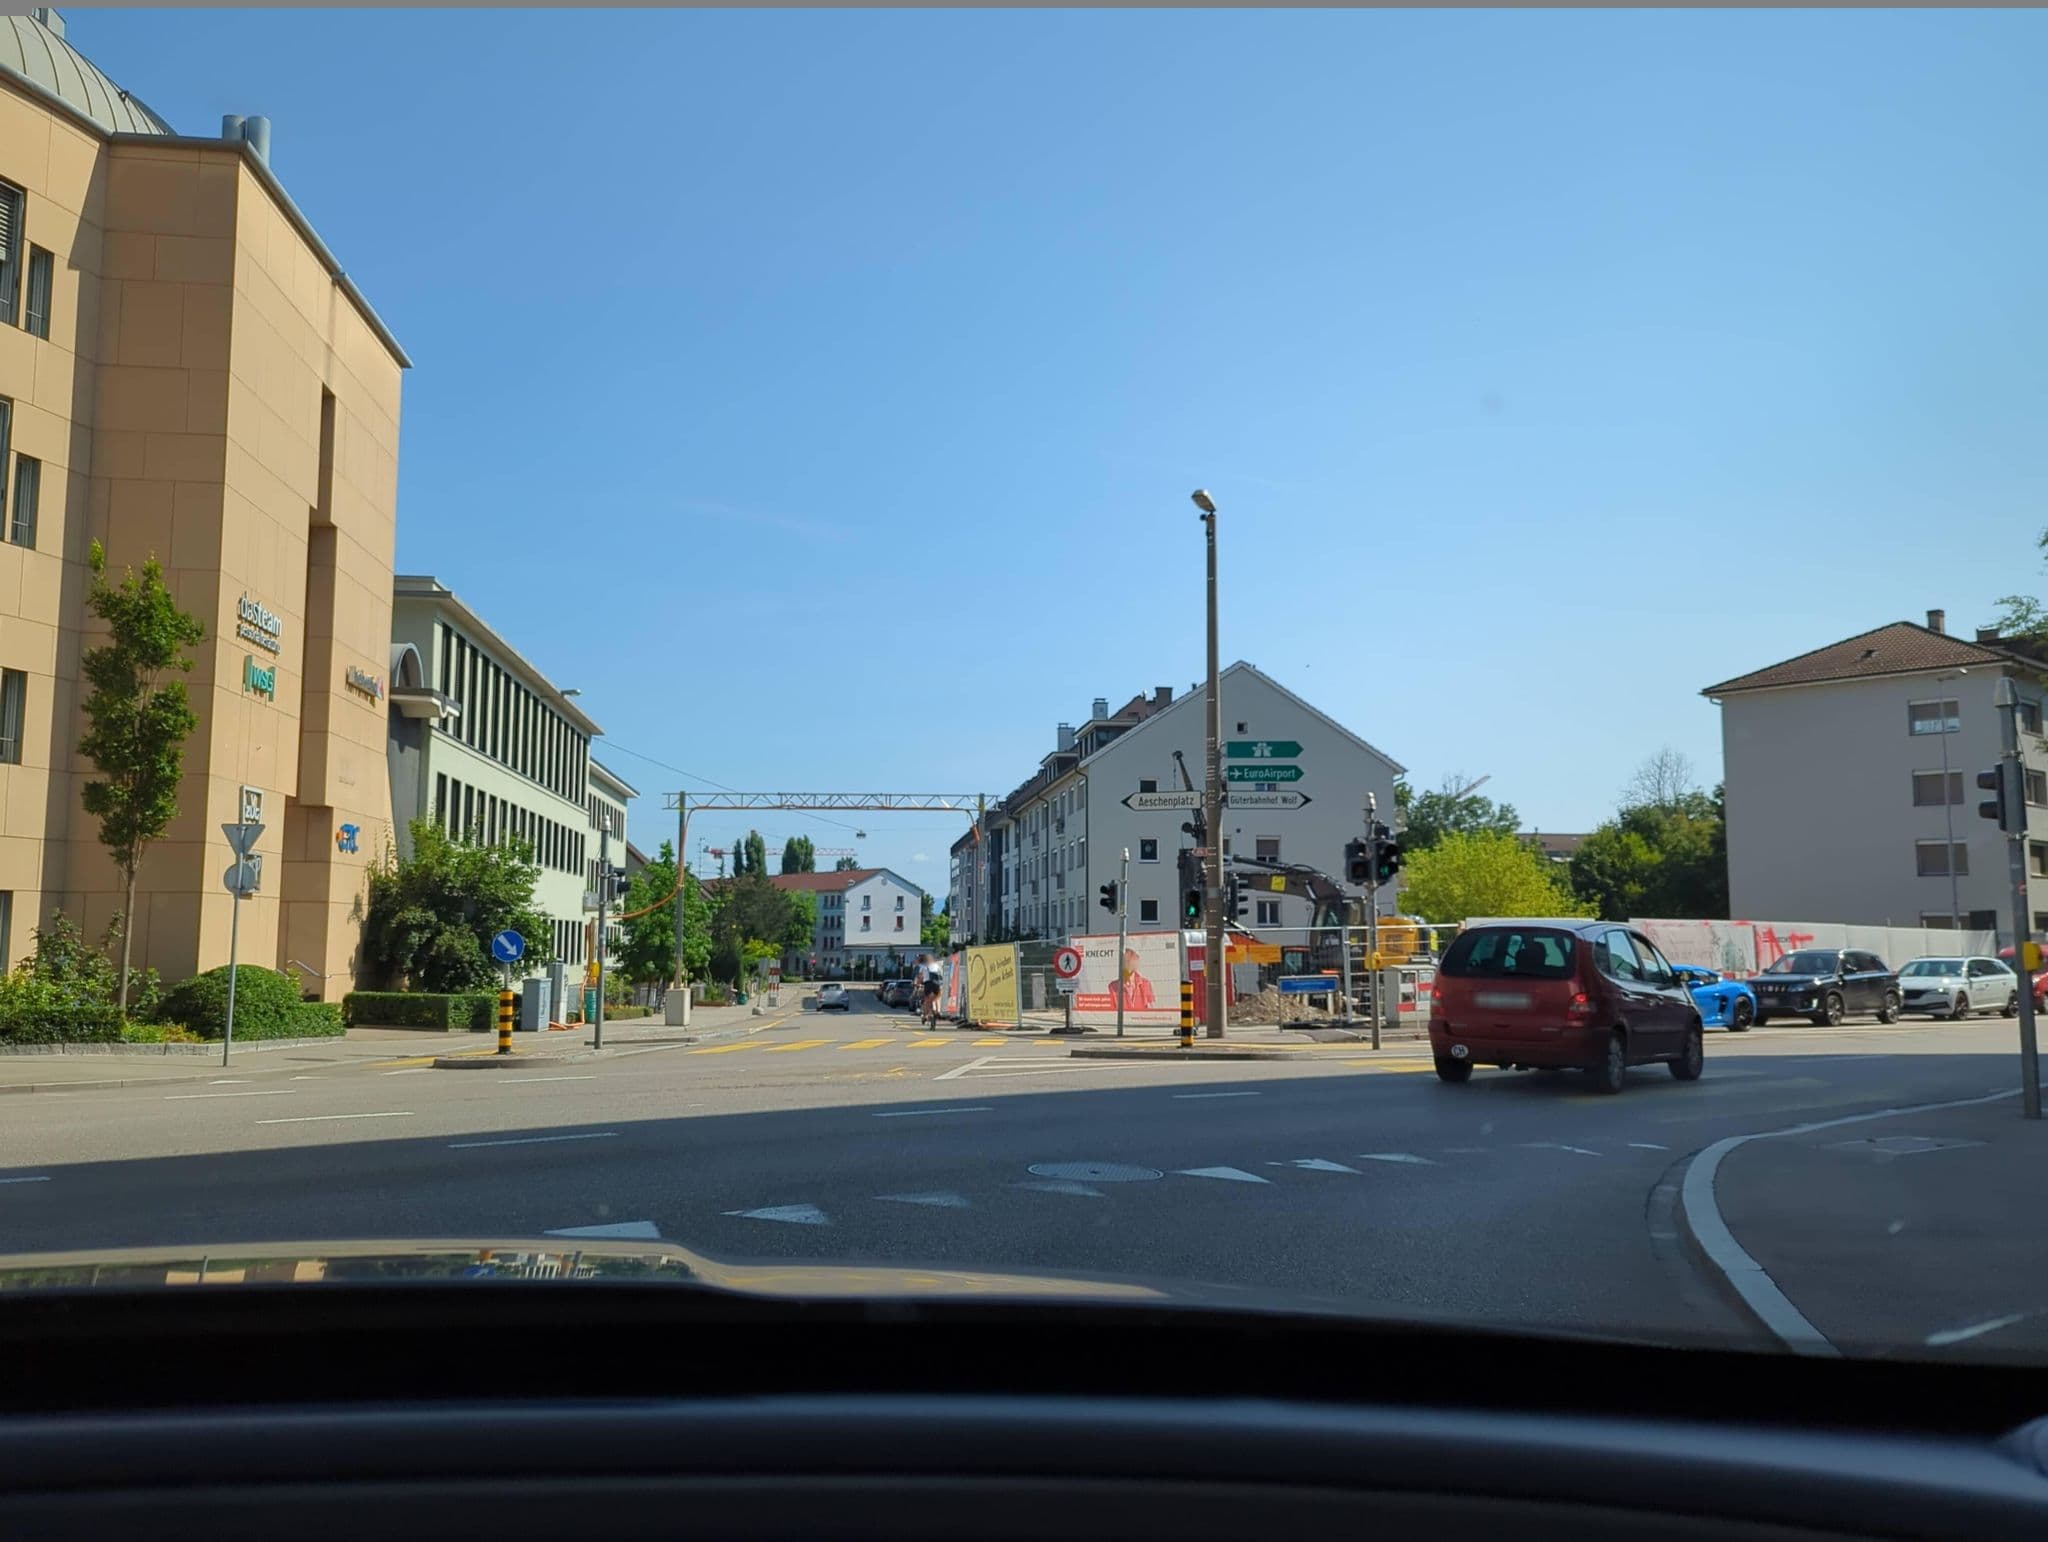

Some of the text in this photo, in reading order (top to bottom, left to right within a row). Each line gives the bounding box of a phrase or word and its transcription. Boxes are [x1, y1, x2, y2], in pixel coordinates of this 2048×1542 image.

[1244, 768, 1296, 780] EuroAirport
[1138, 795, 1194, 808] Aeschenplatz
[1281, 796, 1298, 804] Wolf
[1085, 949, 1114, 958] KNECHT
